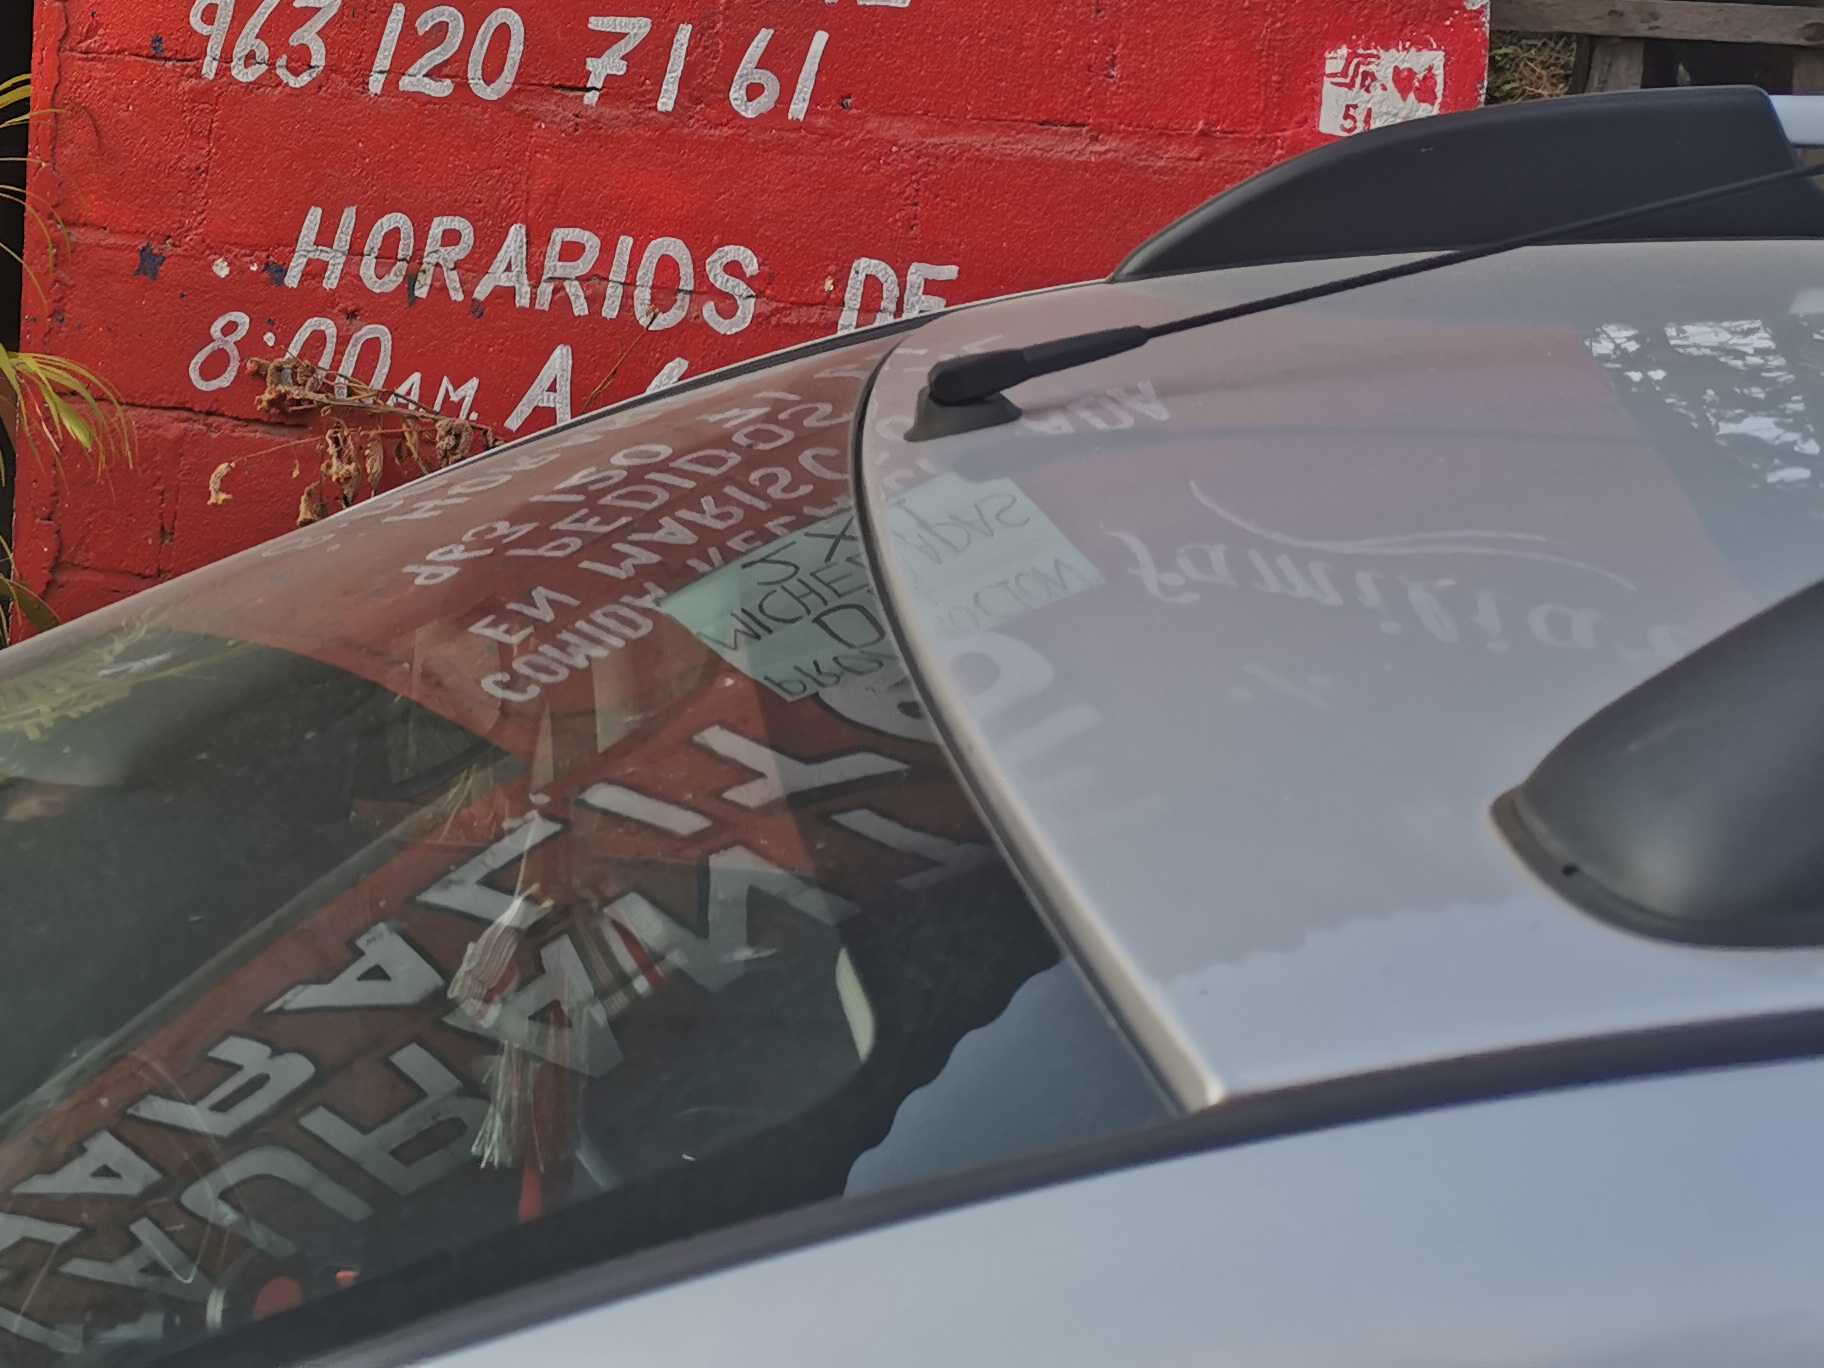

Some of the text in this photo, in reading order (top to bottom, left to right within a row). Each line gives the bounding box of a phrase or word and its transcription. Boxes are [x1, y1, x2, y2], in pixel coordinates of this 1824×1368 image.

[368, 1, 526, 101] 120
[283, 204, 961, 336] HORARIOS DE
